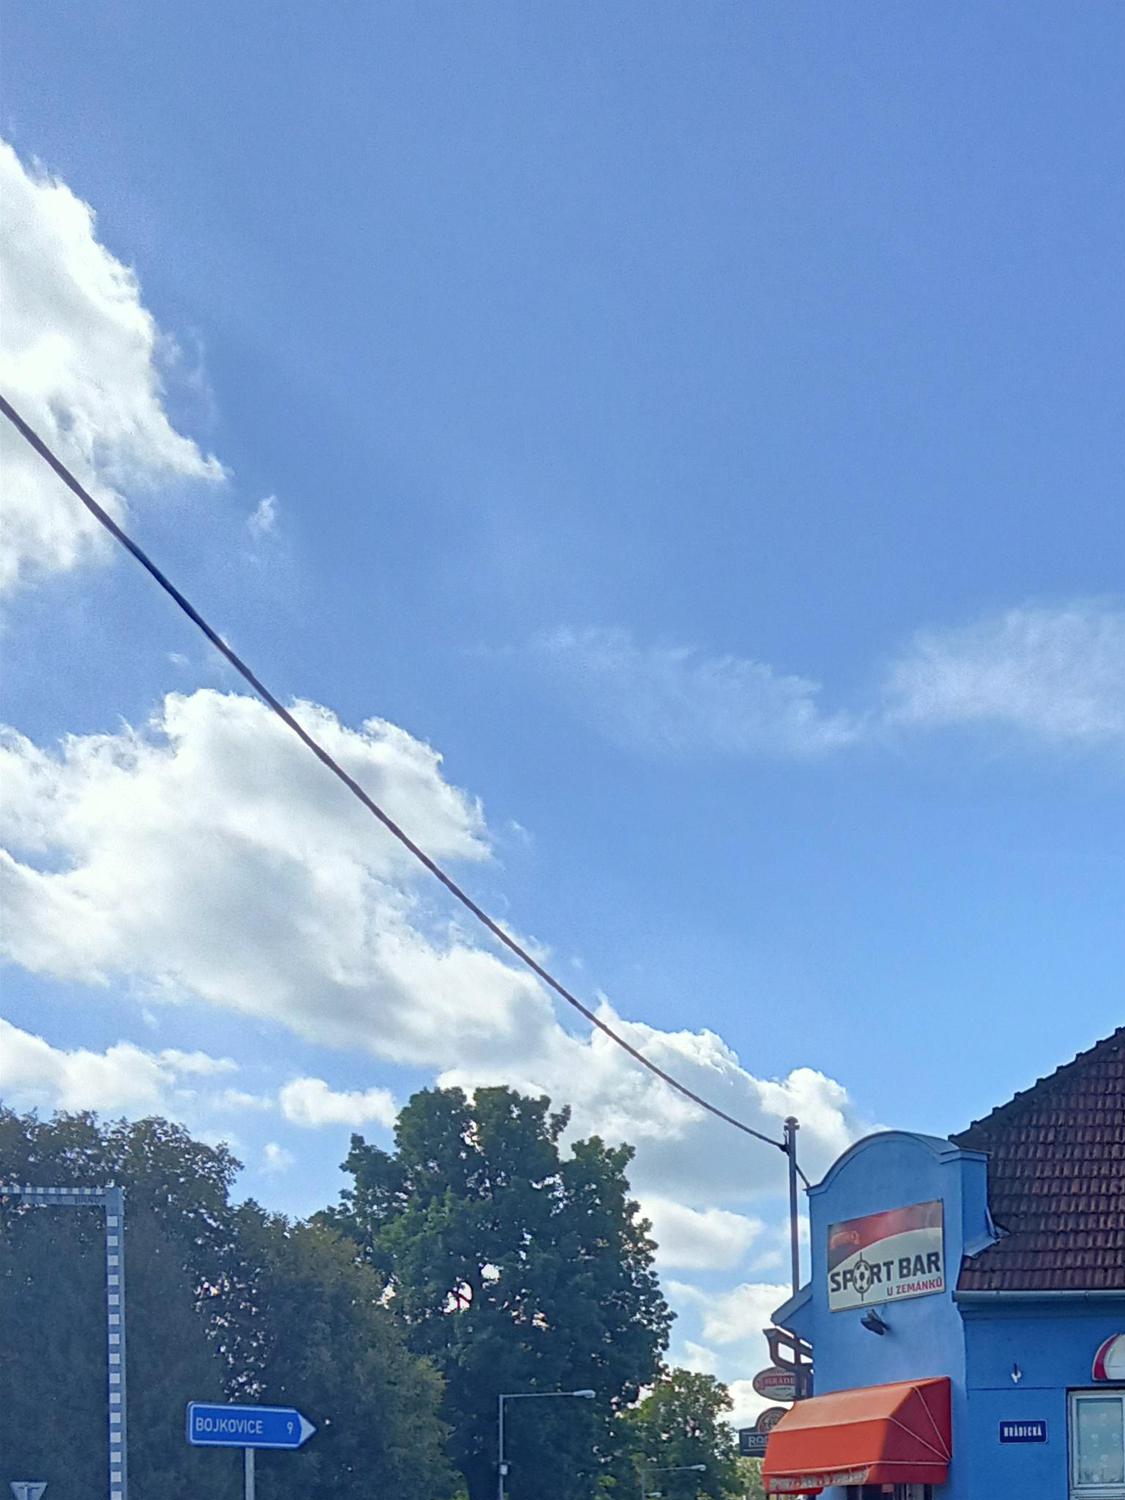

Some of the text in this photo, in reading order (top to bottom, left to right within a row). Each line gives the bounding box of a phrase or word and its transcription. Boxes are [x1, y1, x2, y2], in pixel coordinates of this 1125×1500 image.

[898, 1251, 940, 1279] BAR
[886, 1286, 894, 1297] U
[195, 1417, 295, 1436] BOJKOVICE 9
[1003, 1423, 1043, 1438] HRÁDECKÁ
